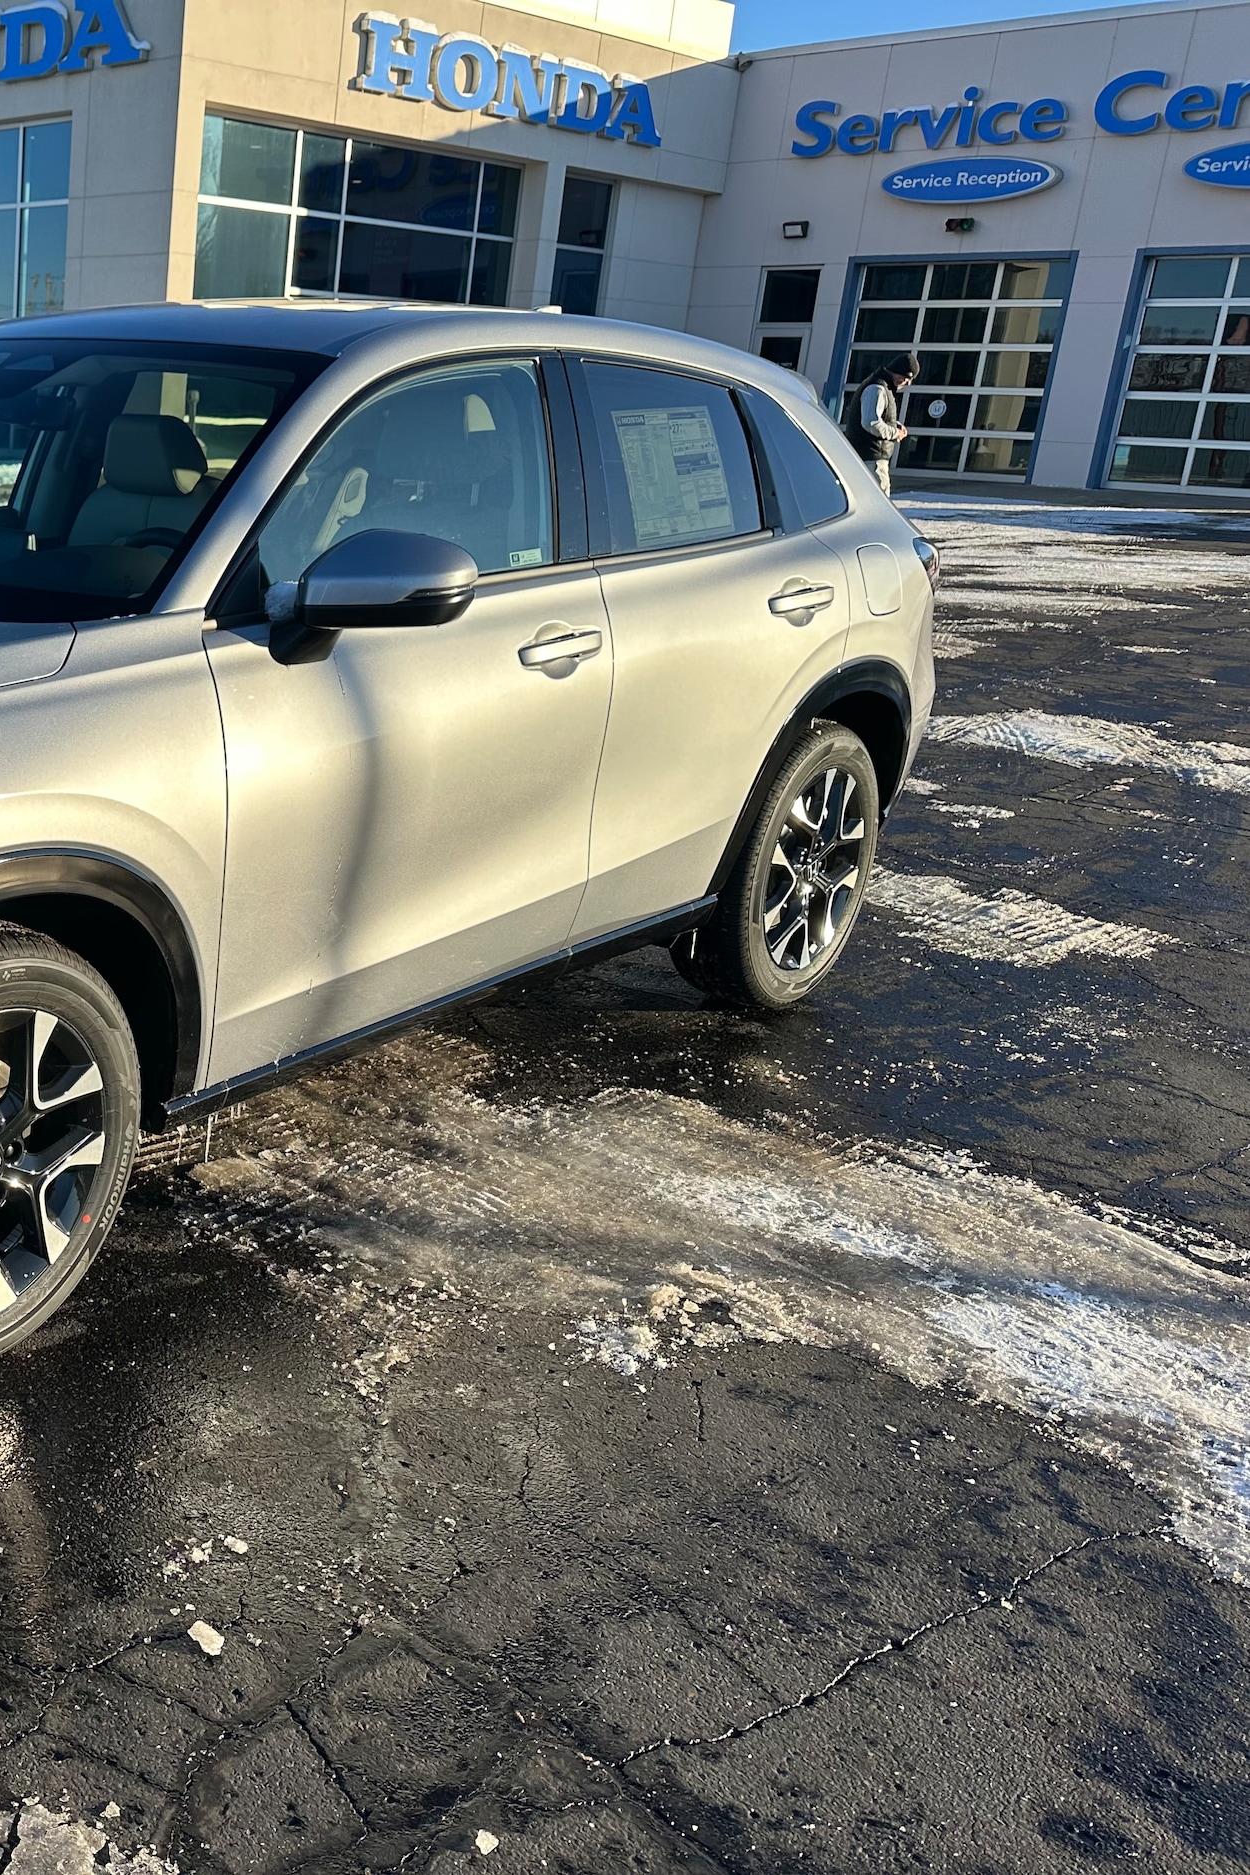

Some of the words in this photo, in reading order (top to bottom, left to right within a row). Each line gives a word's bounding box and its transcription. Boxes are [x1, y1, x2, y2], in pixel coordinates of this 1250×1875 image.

[356, 14, 662, 147] HONDA
[791, 86, 1067, 158] Service
[892, 173, 952, 189] Service
[956, 169, 1042, 188] Reception
[1196, 155, 1250, 173] Servi
